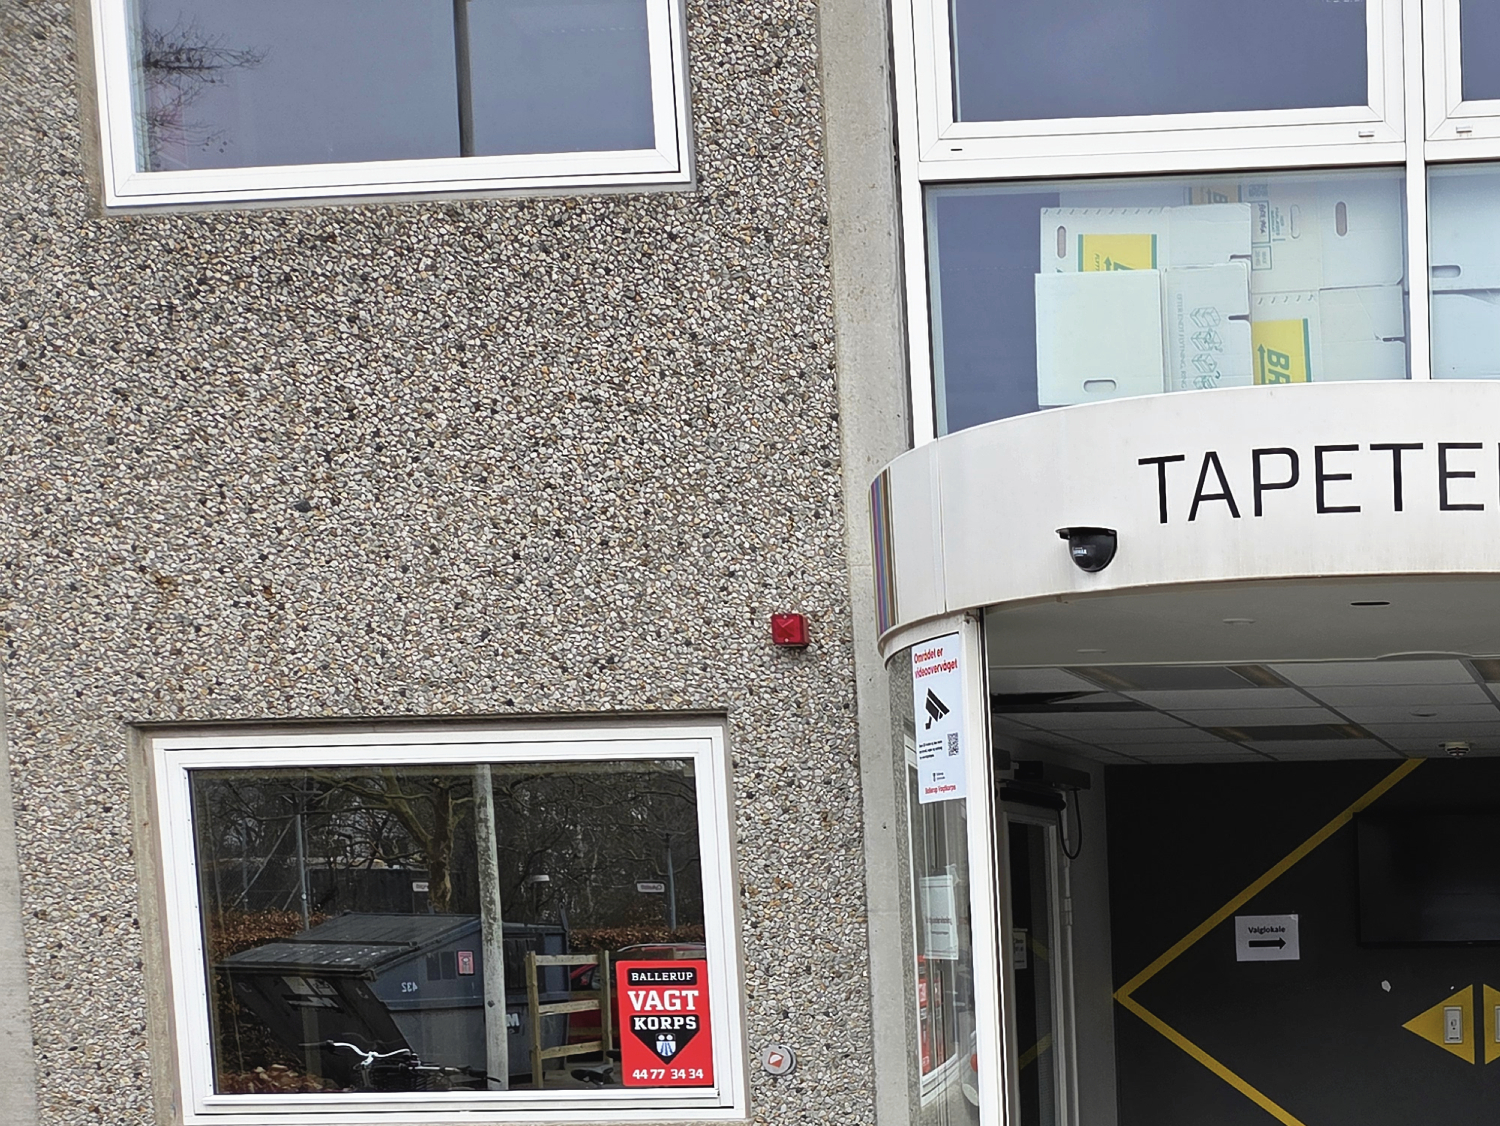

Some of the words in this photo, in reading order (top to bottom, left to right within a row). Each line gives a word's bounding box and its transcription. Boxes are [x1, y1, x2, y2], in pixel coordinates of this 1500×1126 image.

[936, 647, 944, 658] er
[1248, 925, 1287, 935] Valglokale
[631, 971, 694, 982] BALLERUP
[627, 990, 699, 1011] VAGT
[633, 1016, 697, 1031] KORPS
[632, 1069, 648, 1080] 44
[650, 1069, 666, 1080] 77
[671, 1068, 686, 1079] 34
[688, 1068, 704, 1079] 34
